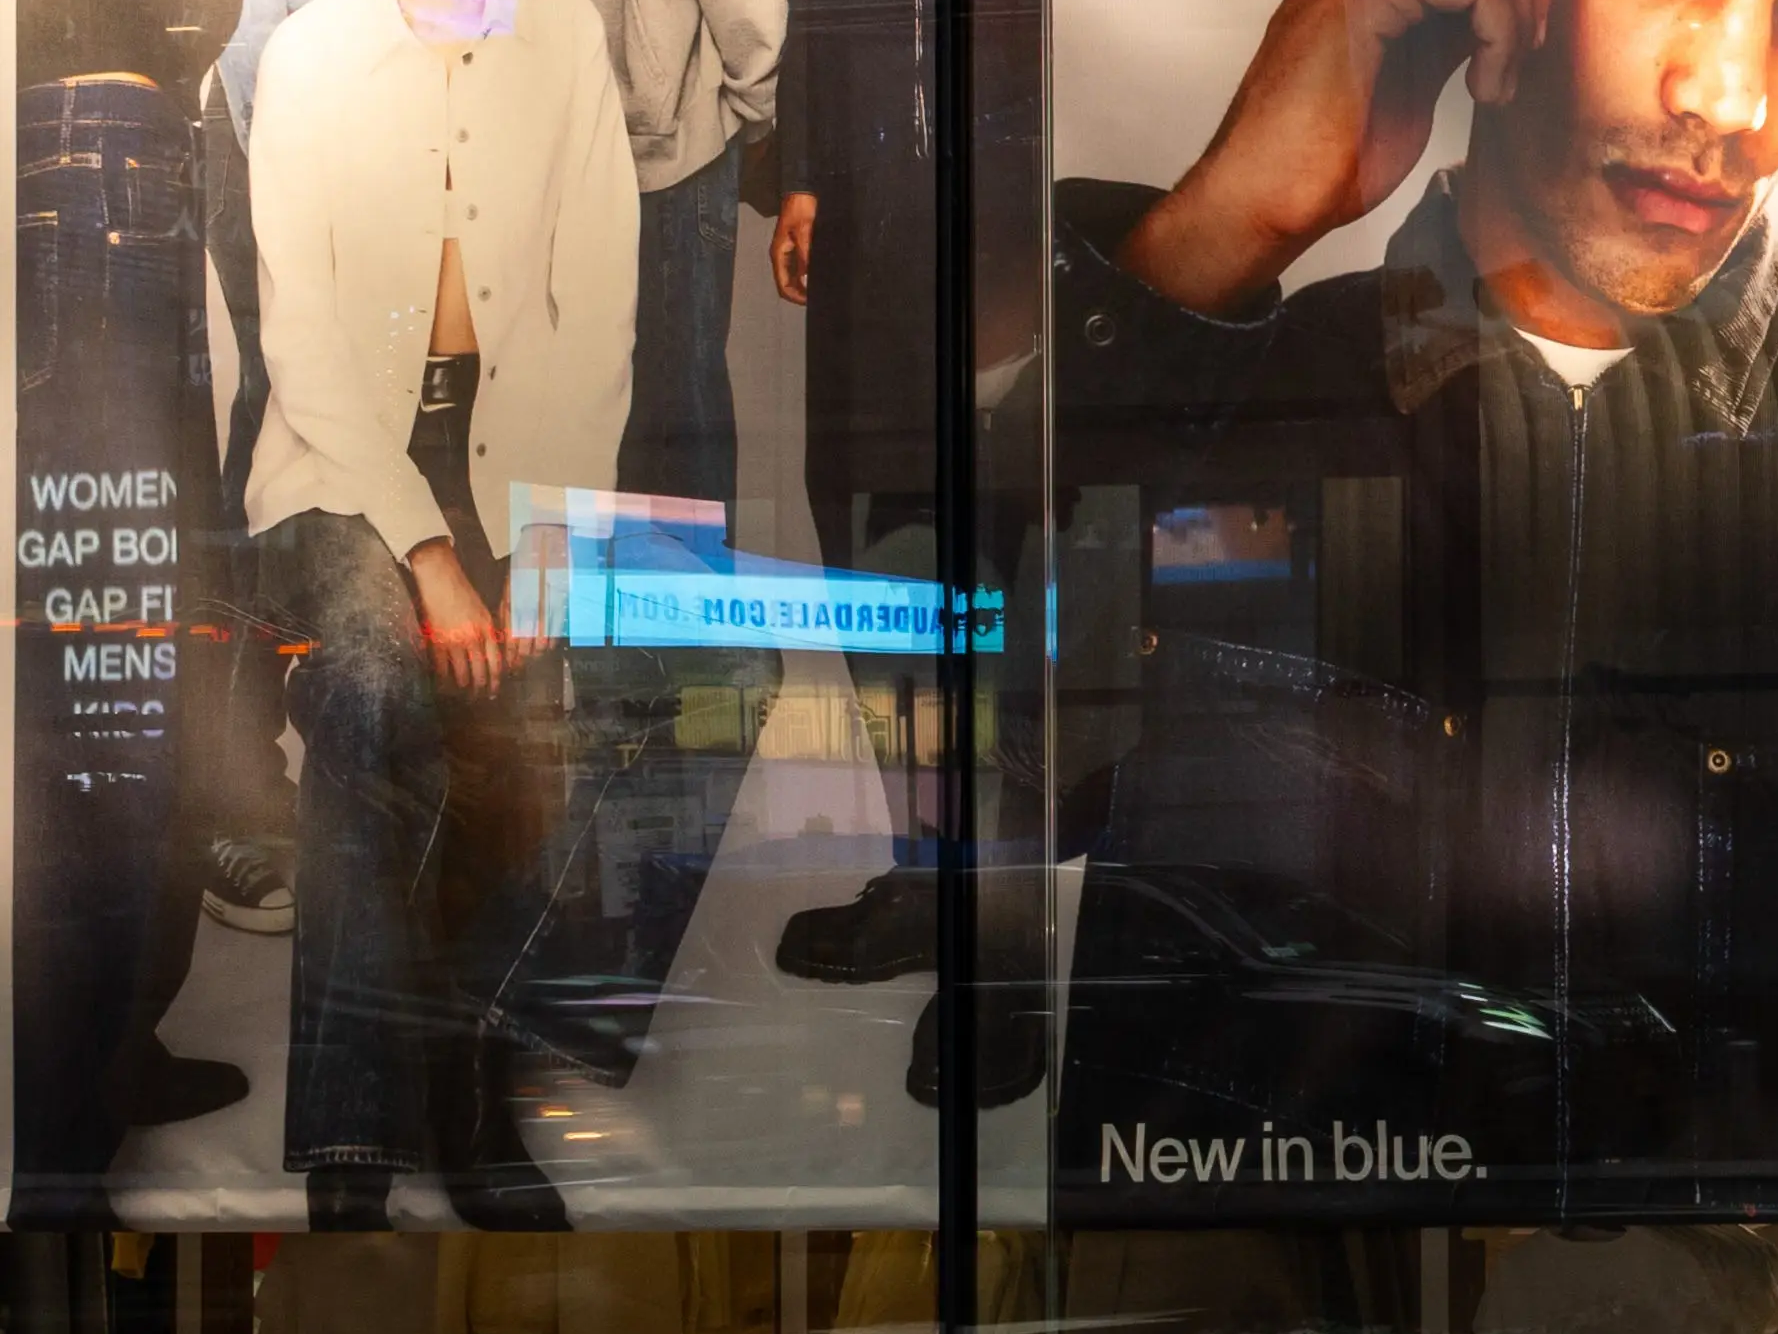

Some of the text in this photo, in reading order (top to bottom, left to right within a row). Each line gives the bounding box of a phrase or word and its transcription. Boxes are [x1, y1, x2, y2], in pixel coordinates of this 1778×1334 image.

[30, 468, 178, 511] WOMEN
[17, 526, 178, 568] GAP BO
[45, 583, 177, 624] GAP FI
[63, 642, 177, 682] MENS
[1100, 1119, 1488, 1184] New in blue.
